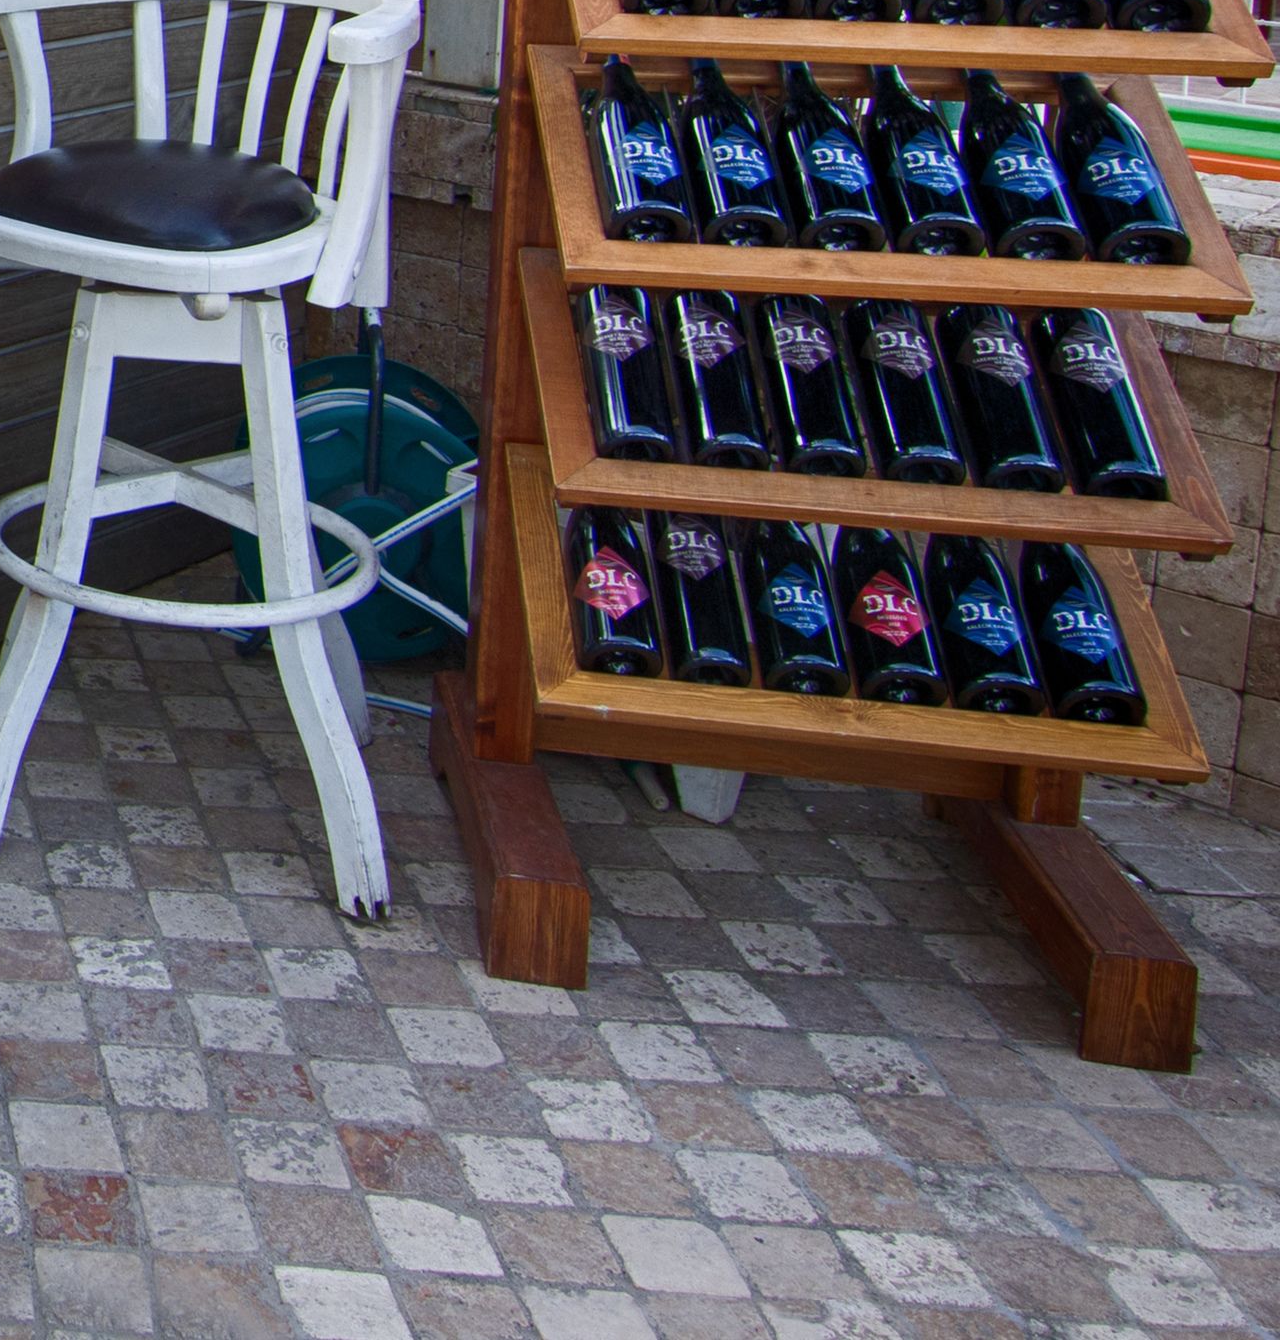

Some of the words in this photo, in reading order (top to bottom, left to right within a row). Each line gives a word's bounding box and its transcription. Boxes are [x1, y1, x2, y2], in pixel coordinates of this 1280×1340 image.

[622, 141, 673, 162] DLC
[712, 144, 765, 166] DLC
[812, 148, 865, 170] DLC
[903, 150, 959, 172] DLC
[994, 151, 1052, 176] DLC
[1088, 157, 1147, 181] DLC
[593, 314, 644, 335] DLC
[680, 320, 731, 342] DLC
[774, 325, 827, 345] DLC
[875, 331, 928, 354] DLC
[973, 337, 1026, 361] DLC
[1063, 343, 1119, 363] DLC
[667, 531, 718, 552] DLC
[587, 569, 637, 590] DLC
[772, 586, 824, 608] DLC
[863, 594, 918, 616] DLC
[958, 602, 1016, 625] DLC
[1053, 610, 1111, 631] DLC
